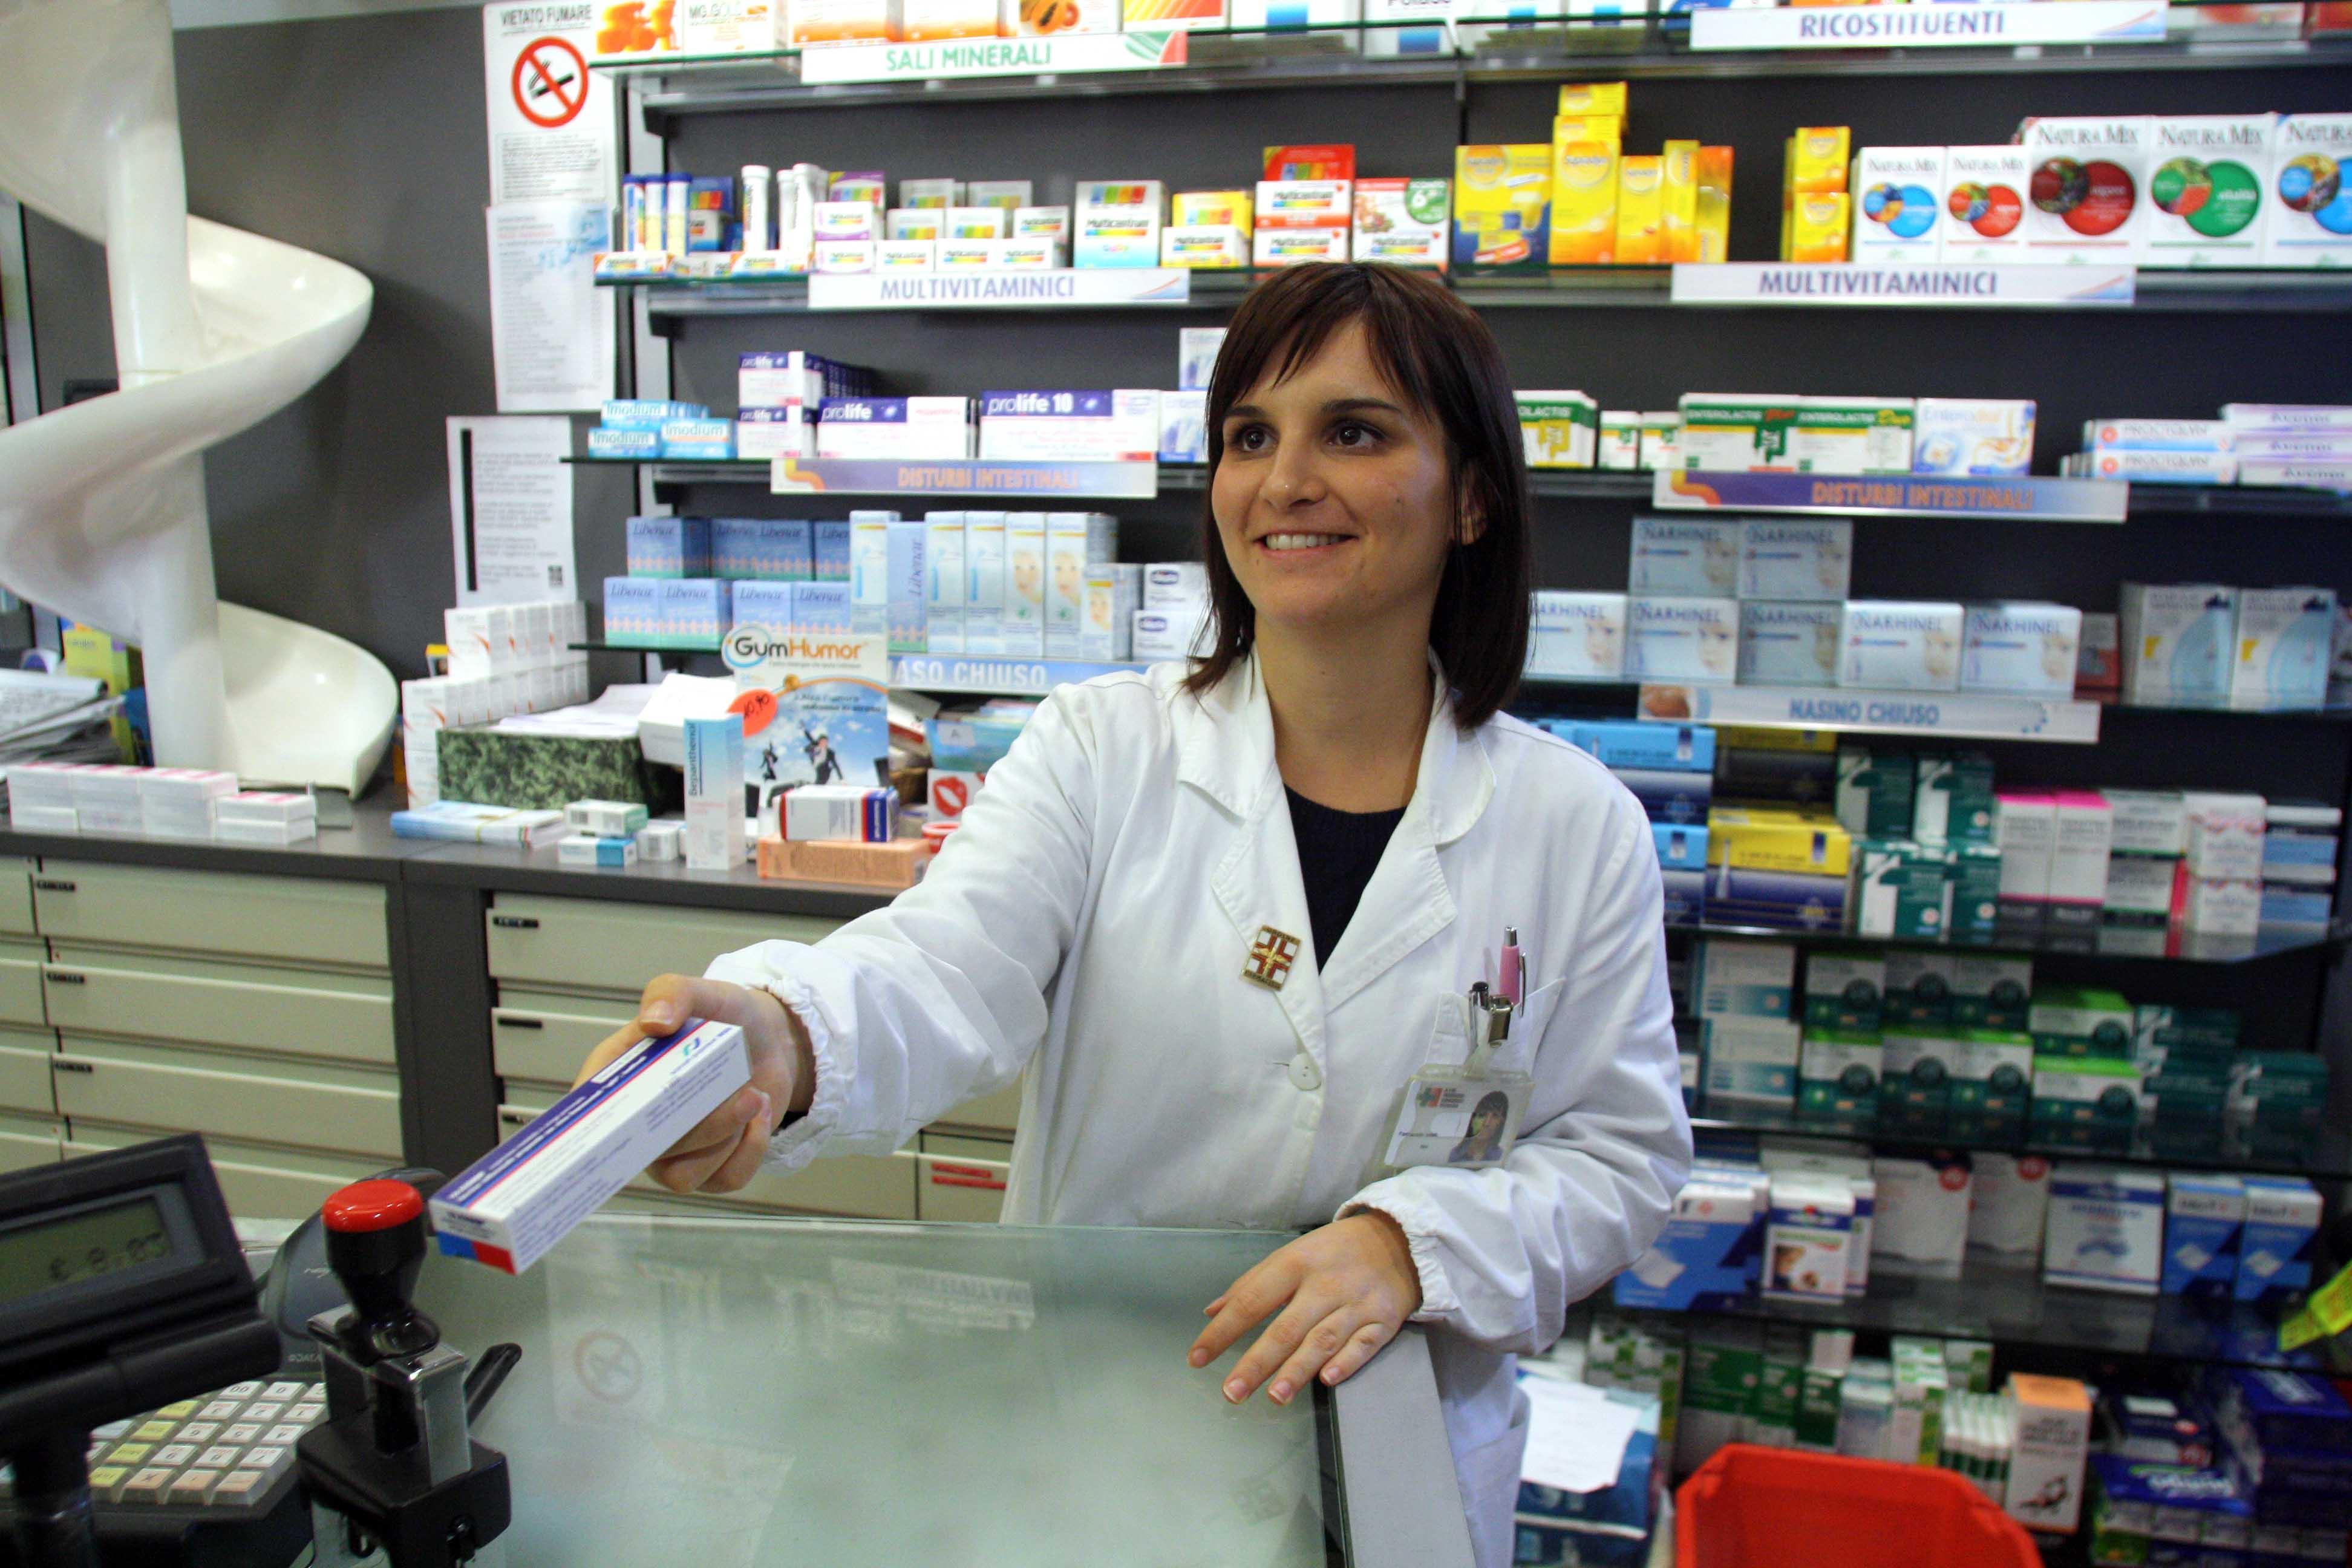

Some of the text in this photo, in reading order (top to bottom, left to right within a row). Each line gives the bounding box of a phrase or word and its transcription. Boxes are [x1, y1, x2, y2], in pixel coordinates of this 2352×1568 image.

[501, 4, 591, 27] VIETATO FUMARE
[1800, 10, 2005, 37] RICOSTITUENTI
[886, 42, 1051, 71] SALI MINERALI
[880, 276, 1074, 300] MULTIVITAMINICI
[1760, 271, 1997, 295] MULTIVITAMINICI
[606, 402, 662, 417] Imodium
[821, 403, 873, 422] prolife
[987, 393, 1050, 416] prolife
[592, 431, 648, 445] Imodium
[665, 423, 723, 437] Imodium
[898, 468, 1080, 489] DISTURBI INTESTINALI
[1812, 482, 2033, 511] DISTURBI INTESTINALI
[1531, 602, 1606, 621] ARHINEL
[734, 636, 861, 659] GumHumor
[953, 661, 1047, 687] CHIUSO
[1789, 698, 1939, 725] NASINO CHIUSO
